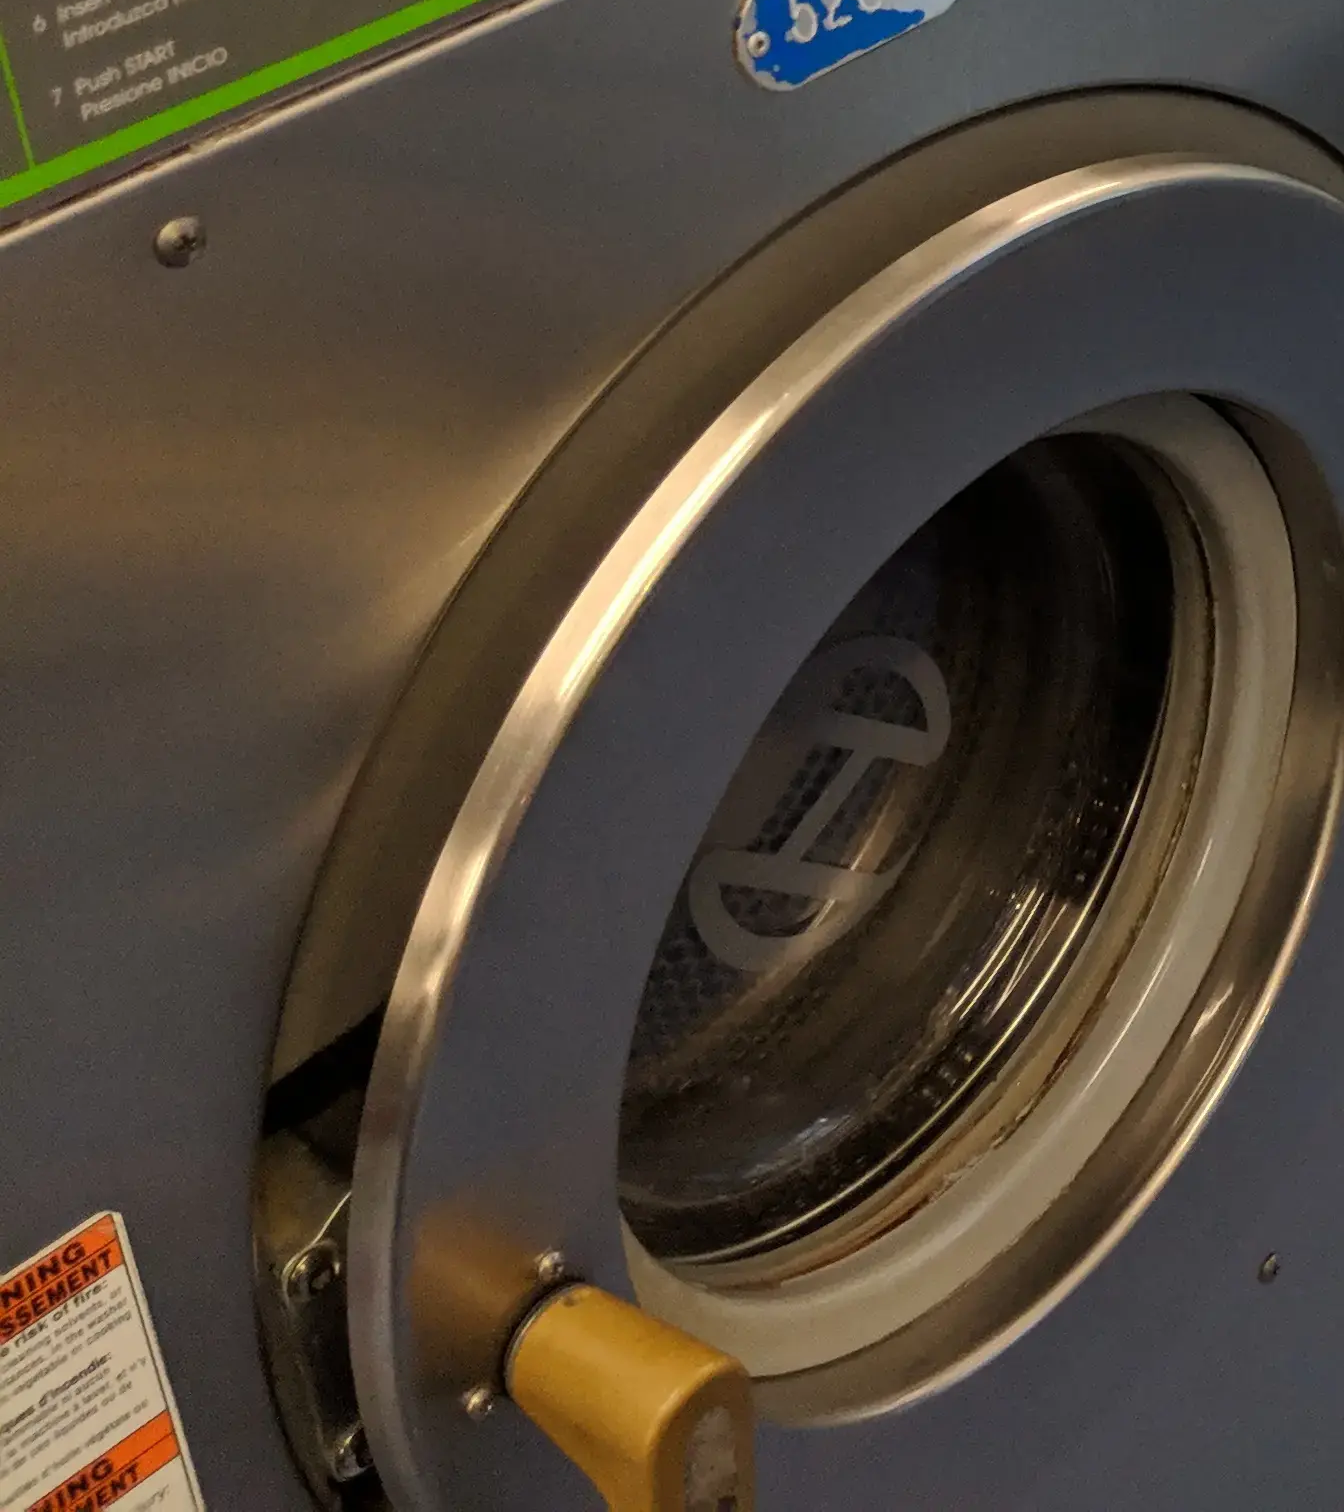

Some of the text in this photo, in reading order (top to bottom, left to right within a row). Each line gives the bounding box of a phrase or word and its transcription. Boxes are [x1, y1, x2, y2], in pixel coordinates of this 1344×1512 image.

[33, 13, 47, 33] 6
[74, 66, 121, 97] Push
[124, 39, 176, 76] START
[81, 47, 228, 122] Presione INICIO
[14, 1280, 108, 1348] risk of fire:
